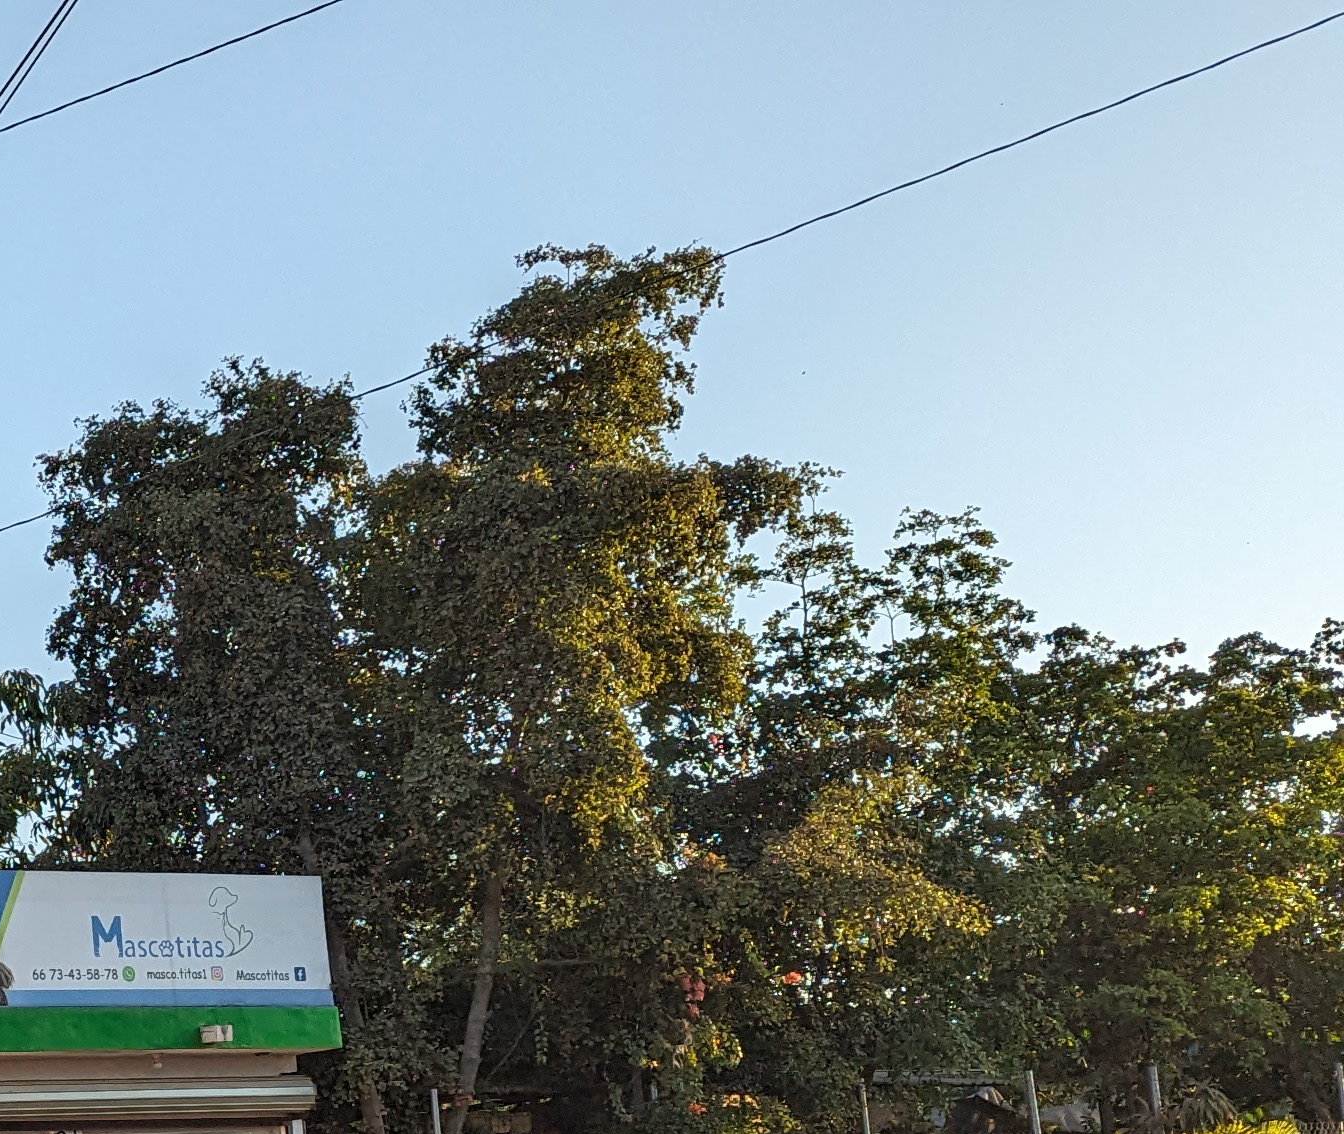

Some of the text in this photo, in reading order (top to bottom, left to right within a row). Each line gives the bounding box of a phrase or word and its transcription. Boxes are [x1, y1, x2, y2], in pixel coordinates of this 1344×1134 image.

[91, 915, 225, 958] Mascotitas
[32, 969, 46, 981] 66
[49, 968, 119, 981] 73-43-58-78
[236, 968, 290, 982] Mascotitas
